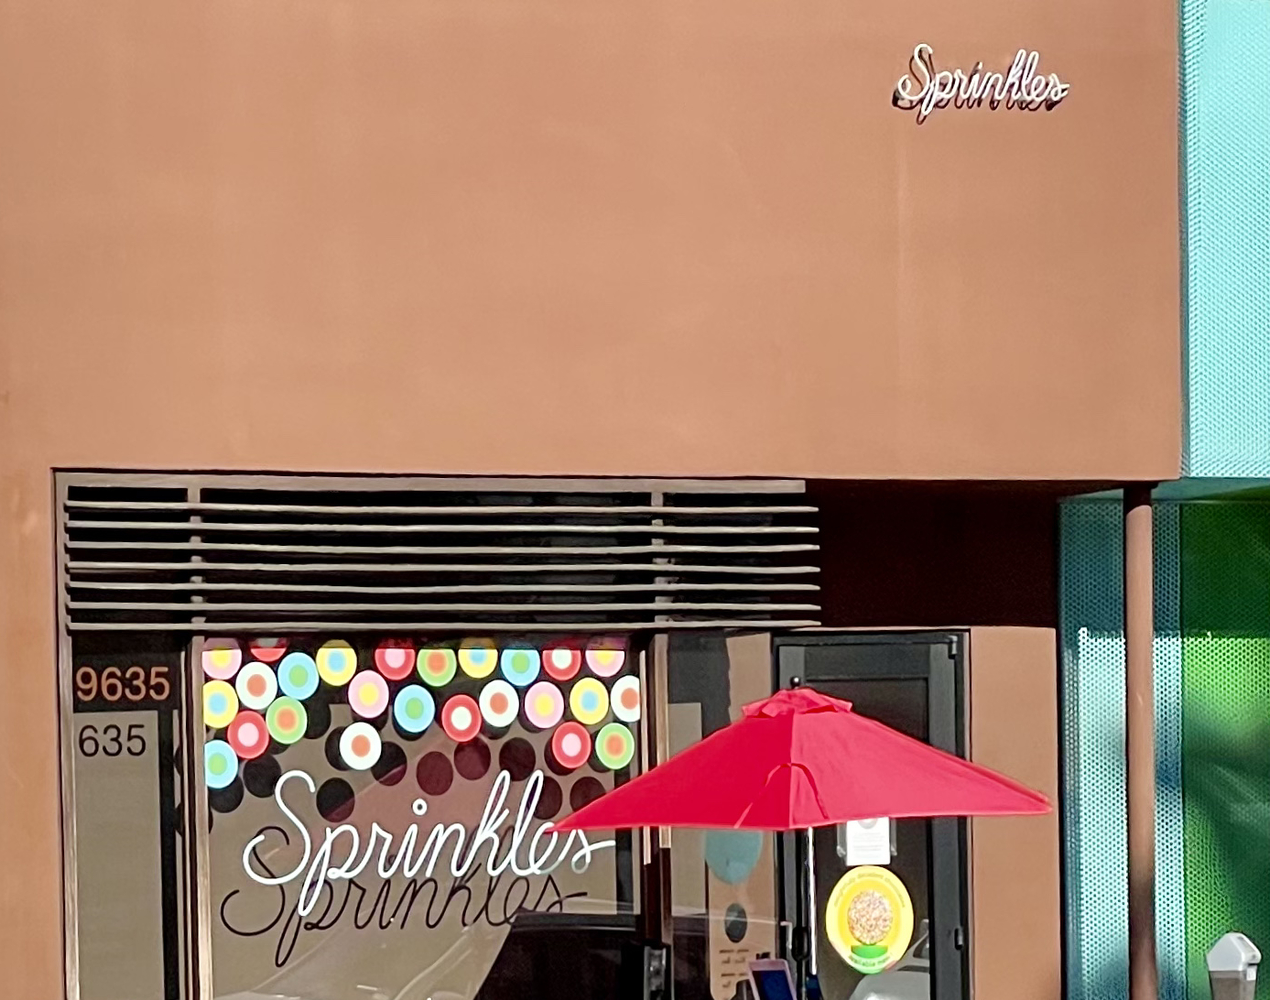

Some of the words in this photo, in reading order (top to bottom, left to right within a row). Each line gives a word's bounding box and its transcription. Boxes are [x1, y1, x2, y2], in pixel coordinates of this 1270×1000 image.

[896, 42, 1070, 117] Sprinkles
[75, 665, 170, 704] 9635
[242, 769, 617, 917] Sprinkles
